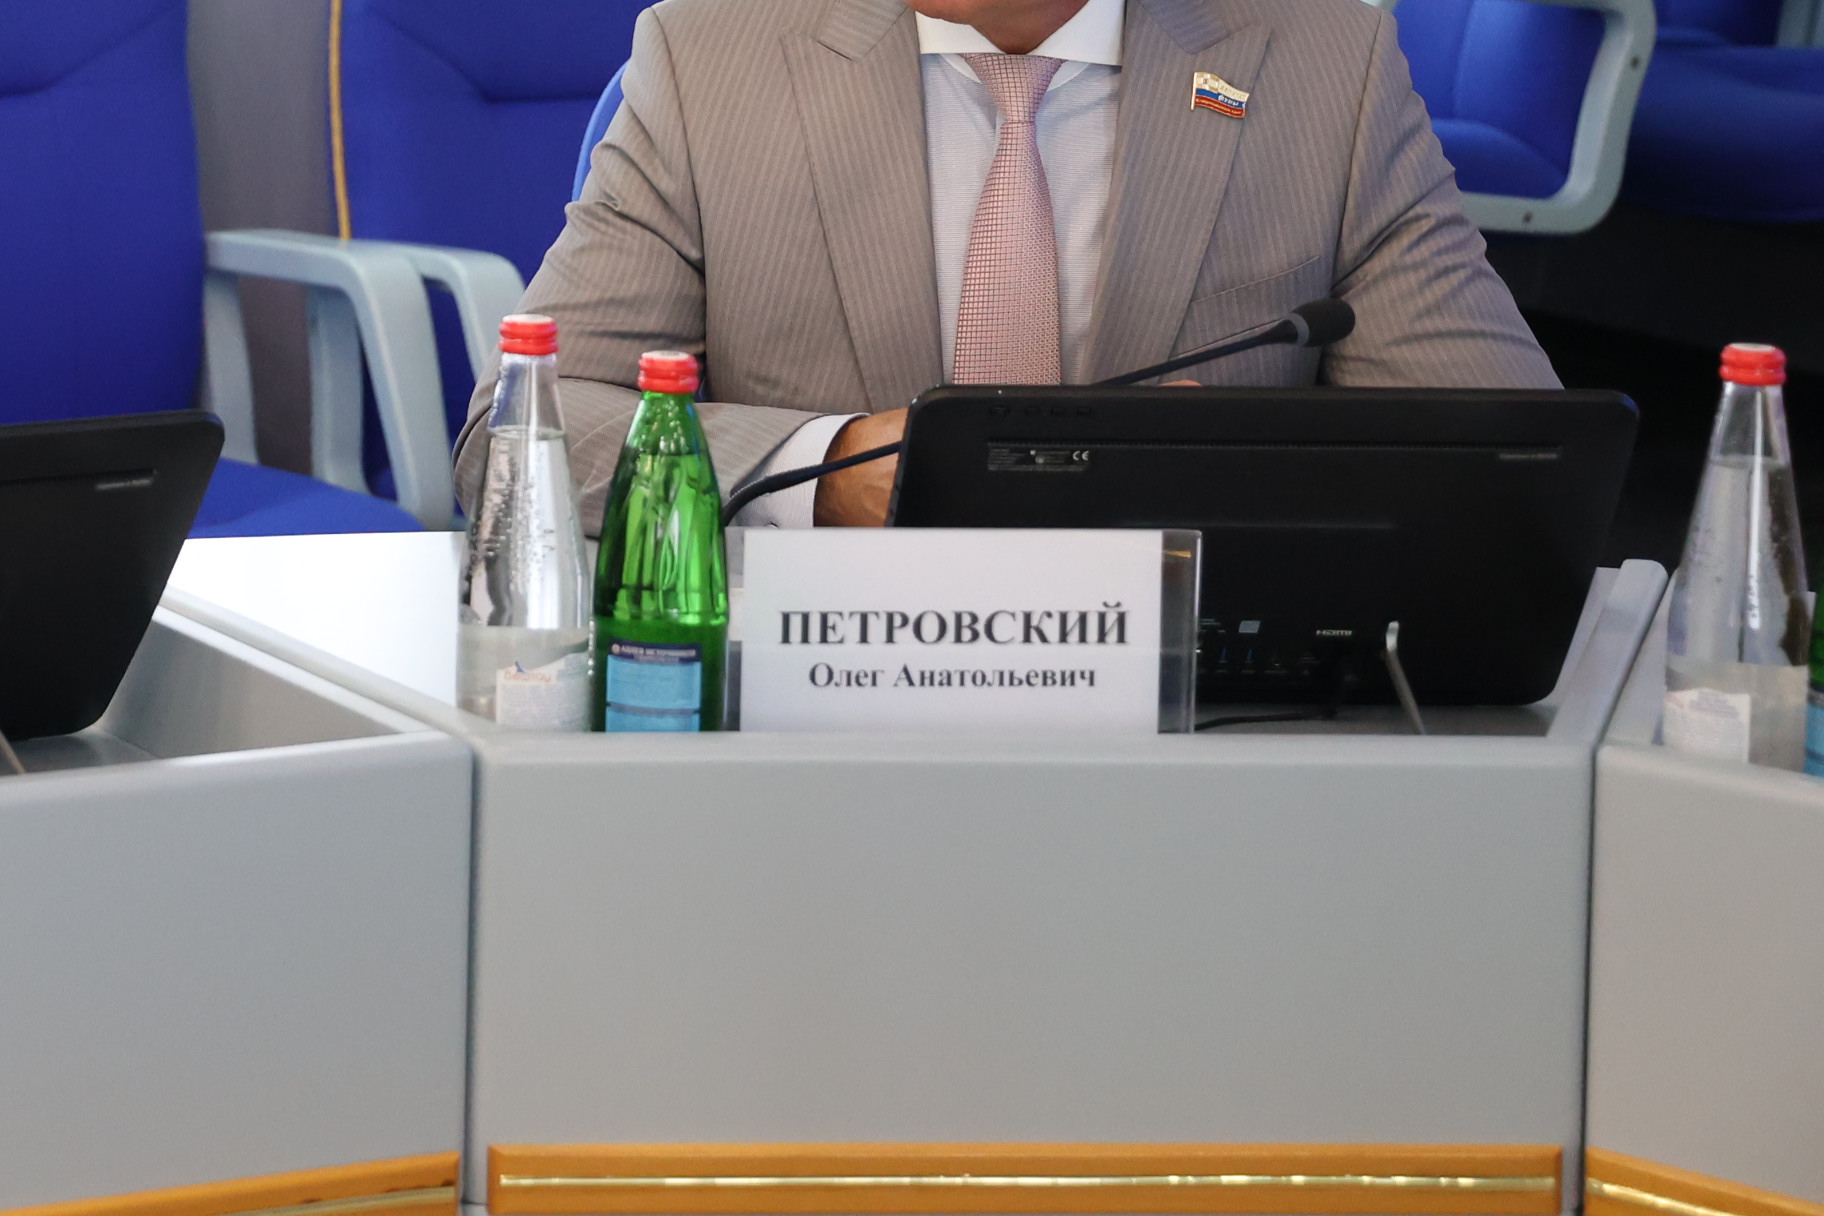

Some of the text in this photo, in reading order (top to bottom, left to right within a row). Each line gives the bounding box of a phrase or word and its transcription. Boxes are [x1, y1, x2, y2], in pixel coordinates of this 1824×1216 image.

[778, 601, 1129, 645] ПЕТРОВСКИЙ
[808, 662, 1096, 688] Олег Анатольевич
